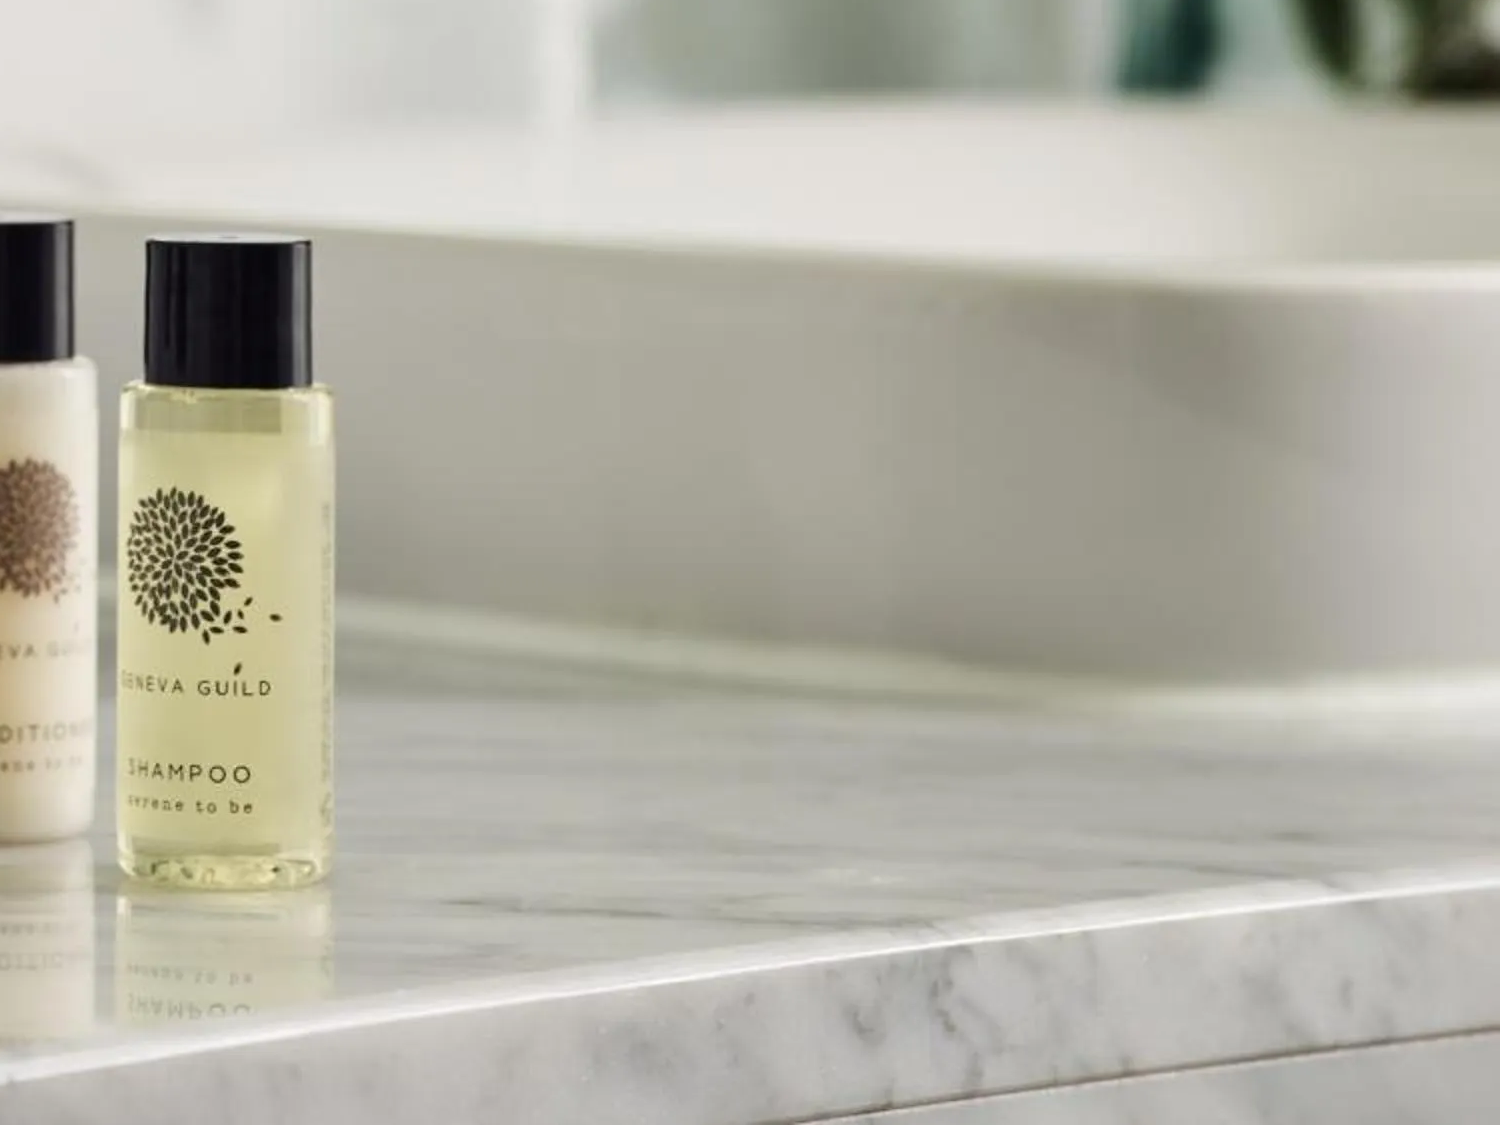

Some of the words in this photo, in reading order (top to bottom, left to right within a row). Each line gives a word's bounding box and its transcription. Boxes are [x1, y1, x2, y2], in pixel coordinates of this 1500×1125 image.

[197, 679, 272, 697] GUILD
[128, 757, 252, 784] SHAMPOO
[195, 799, 218, 815] to
[229, 799, 254, 815] be
